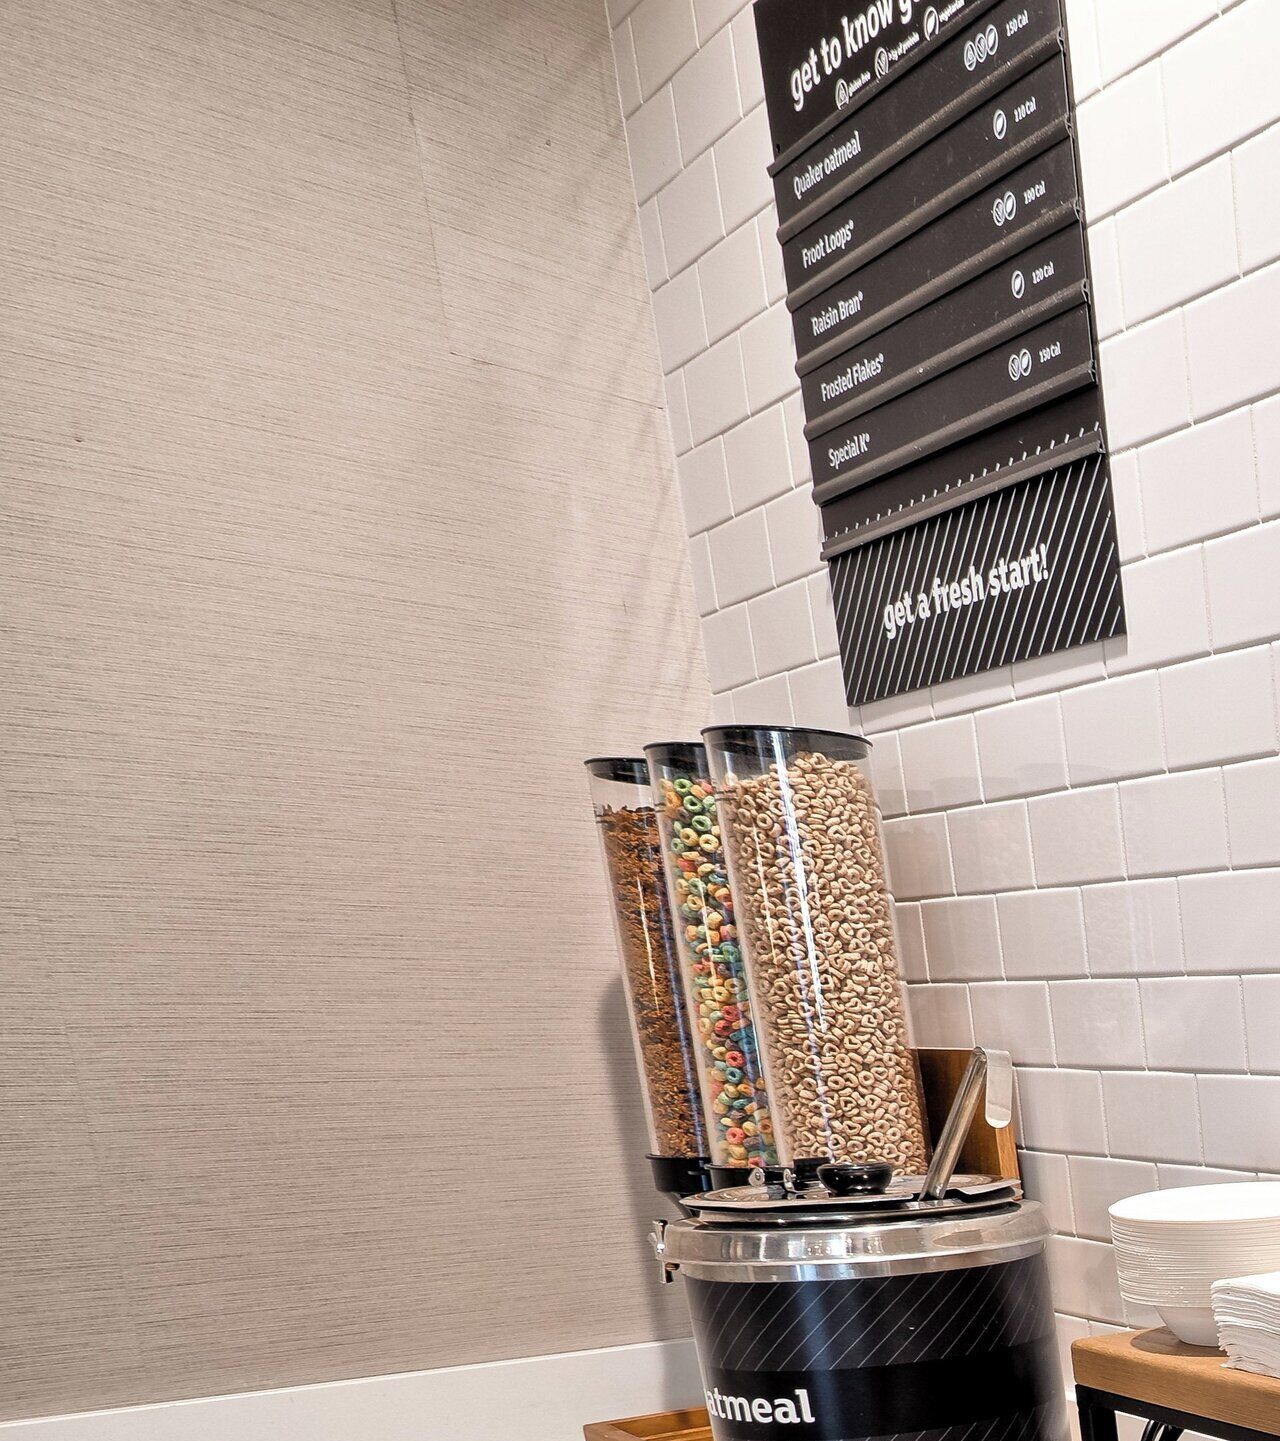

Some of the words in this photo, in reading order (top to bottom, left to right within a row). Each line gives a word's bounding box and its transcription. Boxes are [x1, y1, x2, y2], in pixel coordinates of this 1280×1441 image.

[790, 47, 821, 112] get
[820, 37, 841, 75] to
[841, 0, 893, 58] know
[793, 161, 823, 200] Quaker
[824, 130, 861, 175] oatmeal
[802, 237, 825, 268] Froot
[810, 306, 839, 337] Raisin
[820, 366, 852, 402] Frosted
[828, 434, 860, 470] Special
[884, 593, 915, 640] get
[918, 595, 931, 621] a
[931, 565, 986, 614] fresh
[988, 543, 1050, 598] start!
[706, 1387, 816, 1424] atmeal
